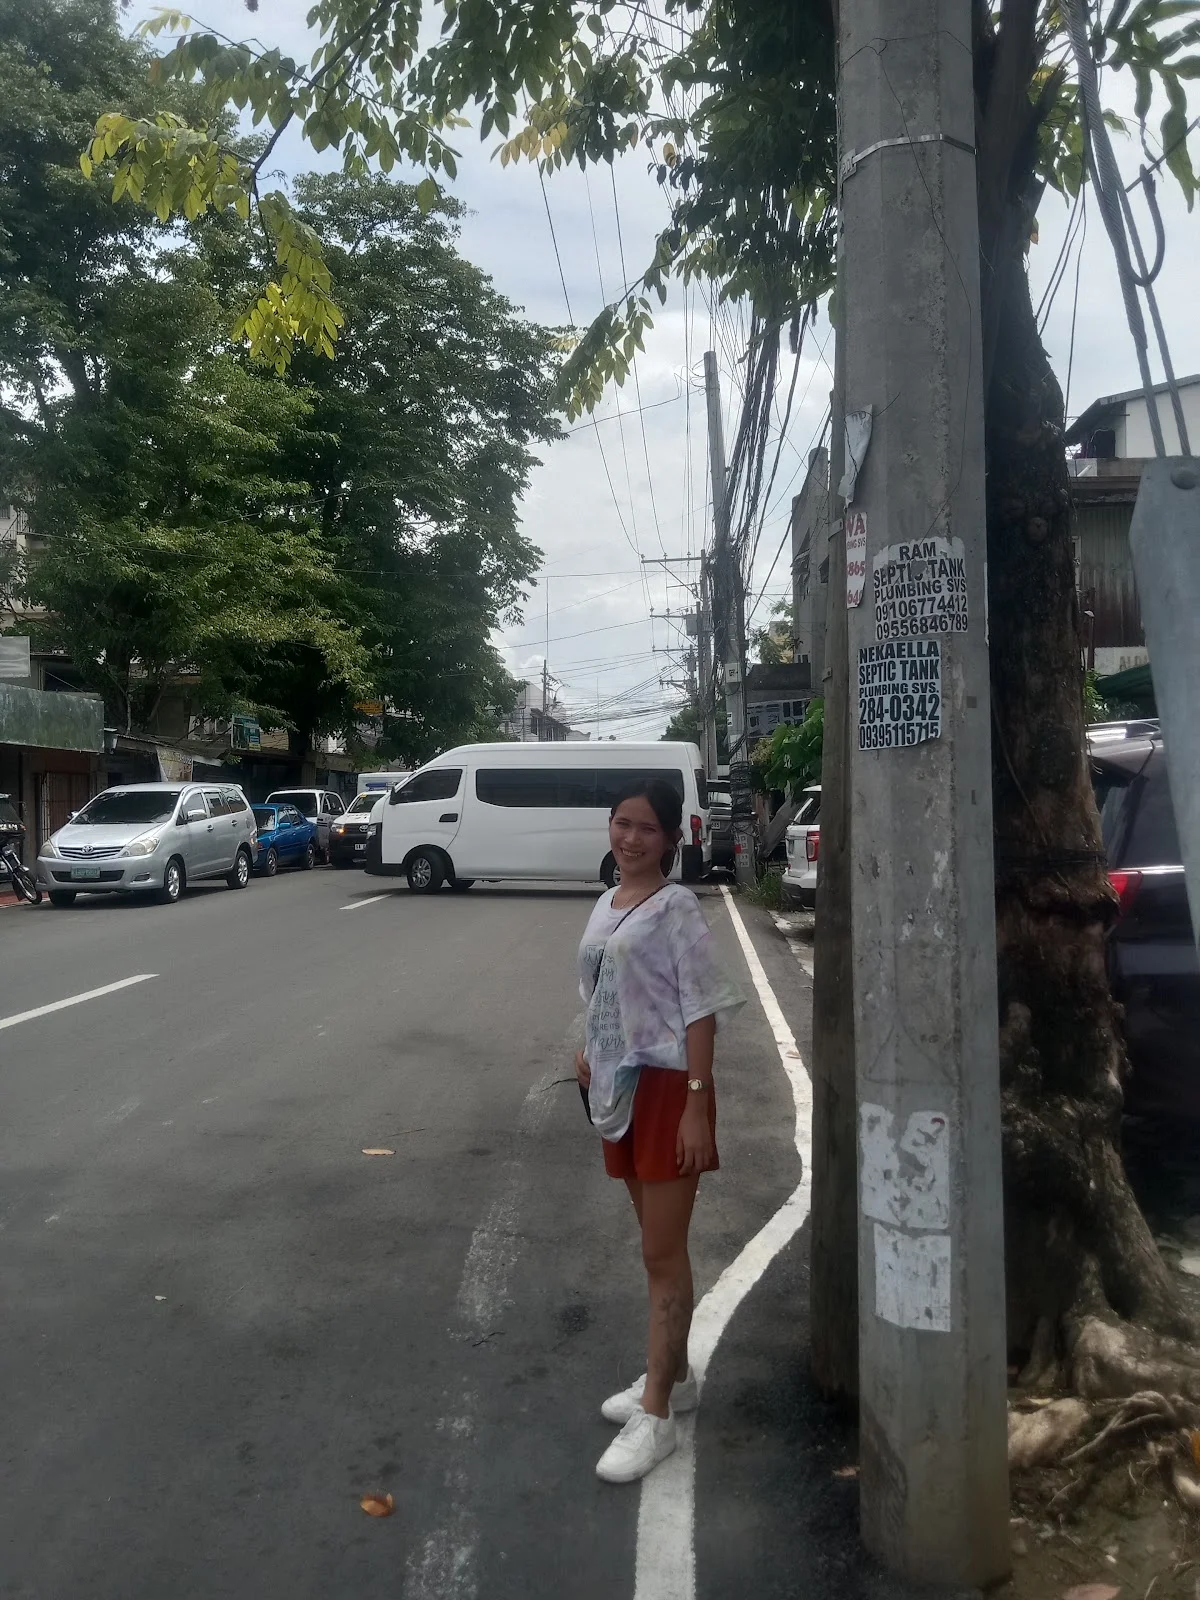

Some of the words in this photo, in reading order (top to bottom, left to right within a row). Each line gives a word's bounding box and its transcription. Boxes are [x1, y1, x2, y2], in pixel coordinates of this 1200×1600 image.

[899, 541, 937, 561] RAM
[927, 558, 965, 579] TANK
[875, 580, 942, 603] PLUMBING
[947, 578, 966, 593] SVS
[876, 595, 967, 622] 09106774412
[877, 614, 968, 640] 09556846789
[860, 641, 939, 664] NEKAELLA
[860, 660, 896, 685] SEPTIC
[900, 659, 939, 680] TANK
[860, 682, 908, 698] PLUMBING
[912, 681, 939, 694] SVS.
[860, 694, 939, 724] 284-0342
[860, 722, 938, 748] 09395115715
